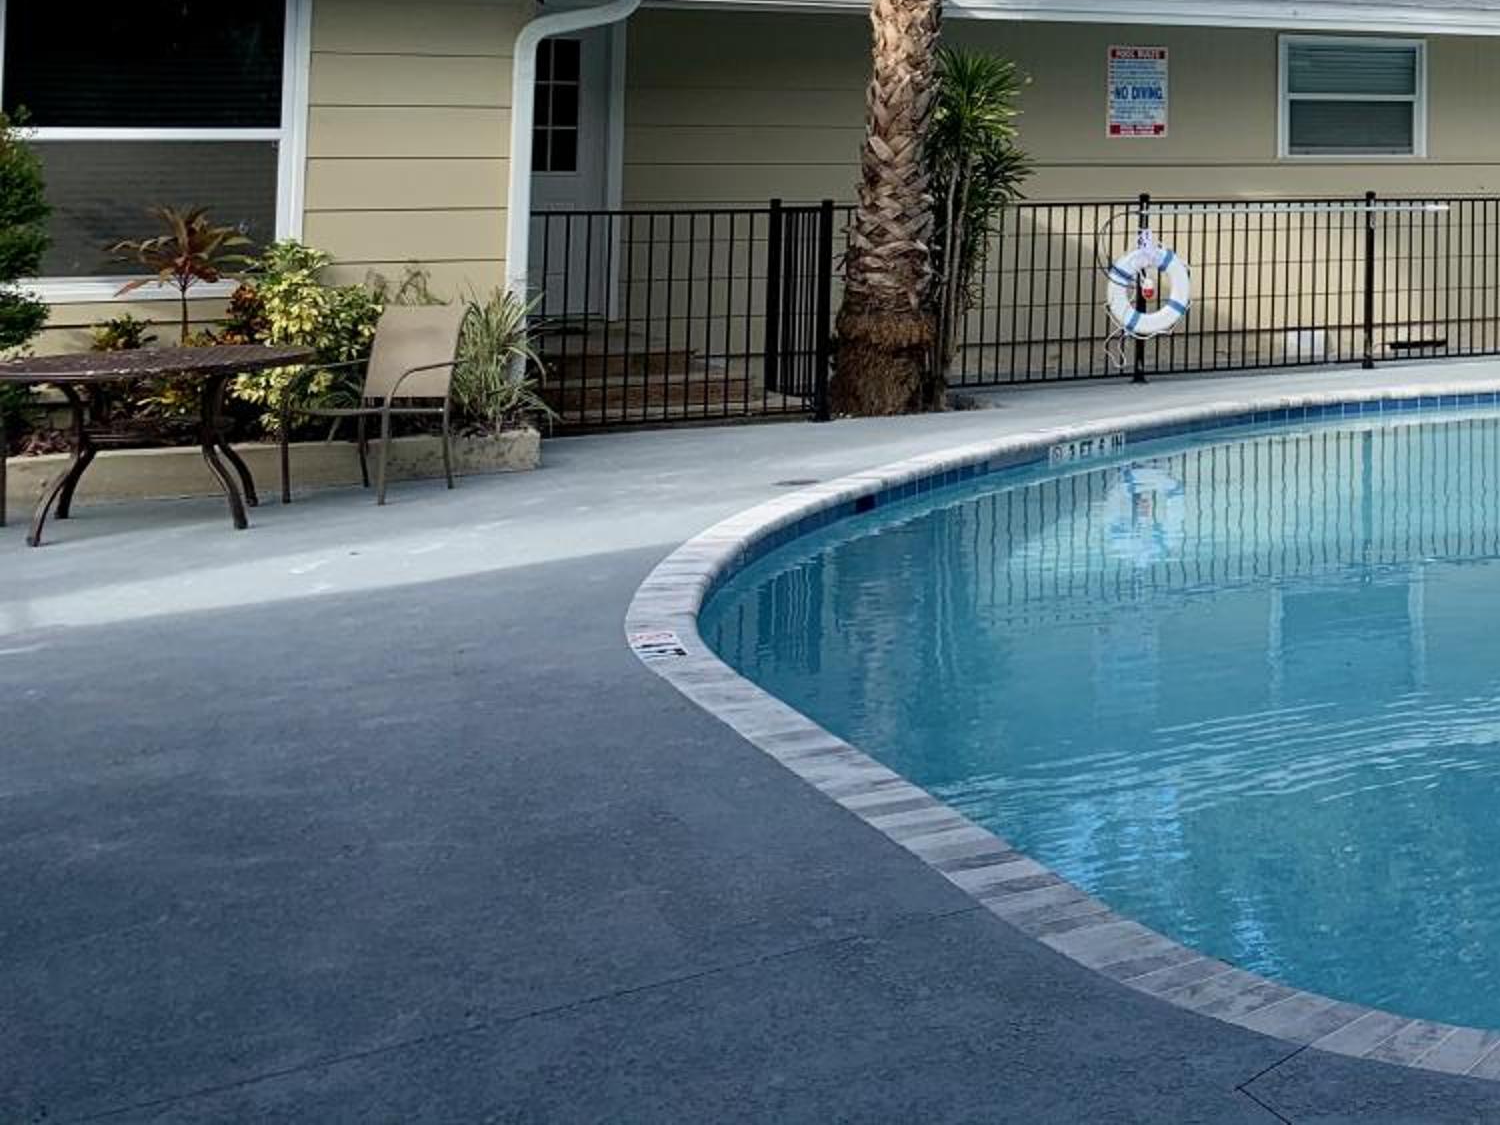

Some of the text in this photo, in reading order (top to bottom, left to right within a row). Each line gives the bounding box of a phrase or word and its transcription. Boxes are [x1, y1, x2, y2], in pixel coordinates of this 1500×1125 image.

[1115, 86, 1163, 100] NO DIVING
[1080, 440, 1093, 455] FT
